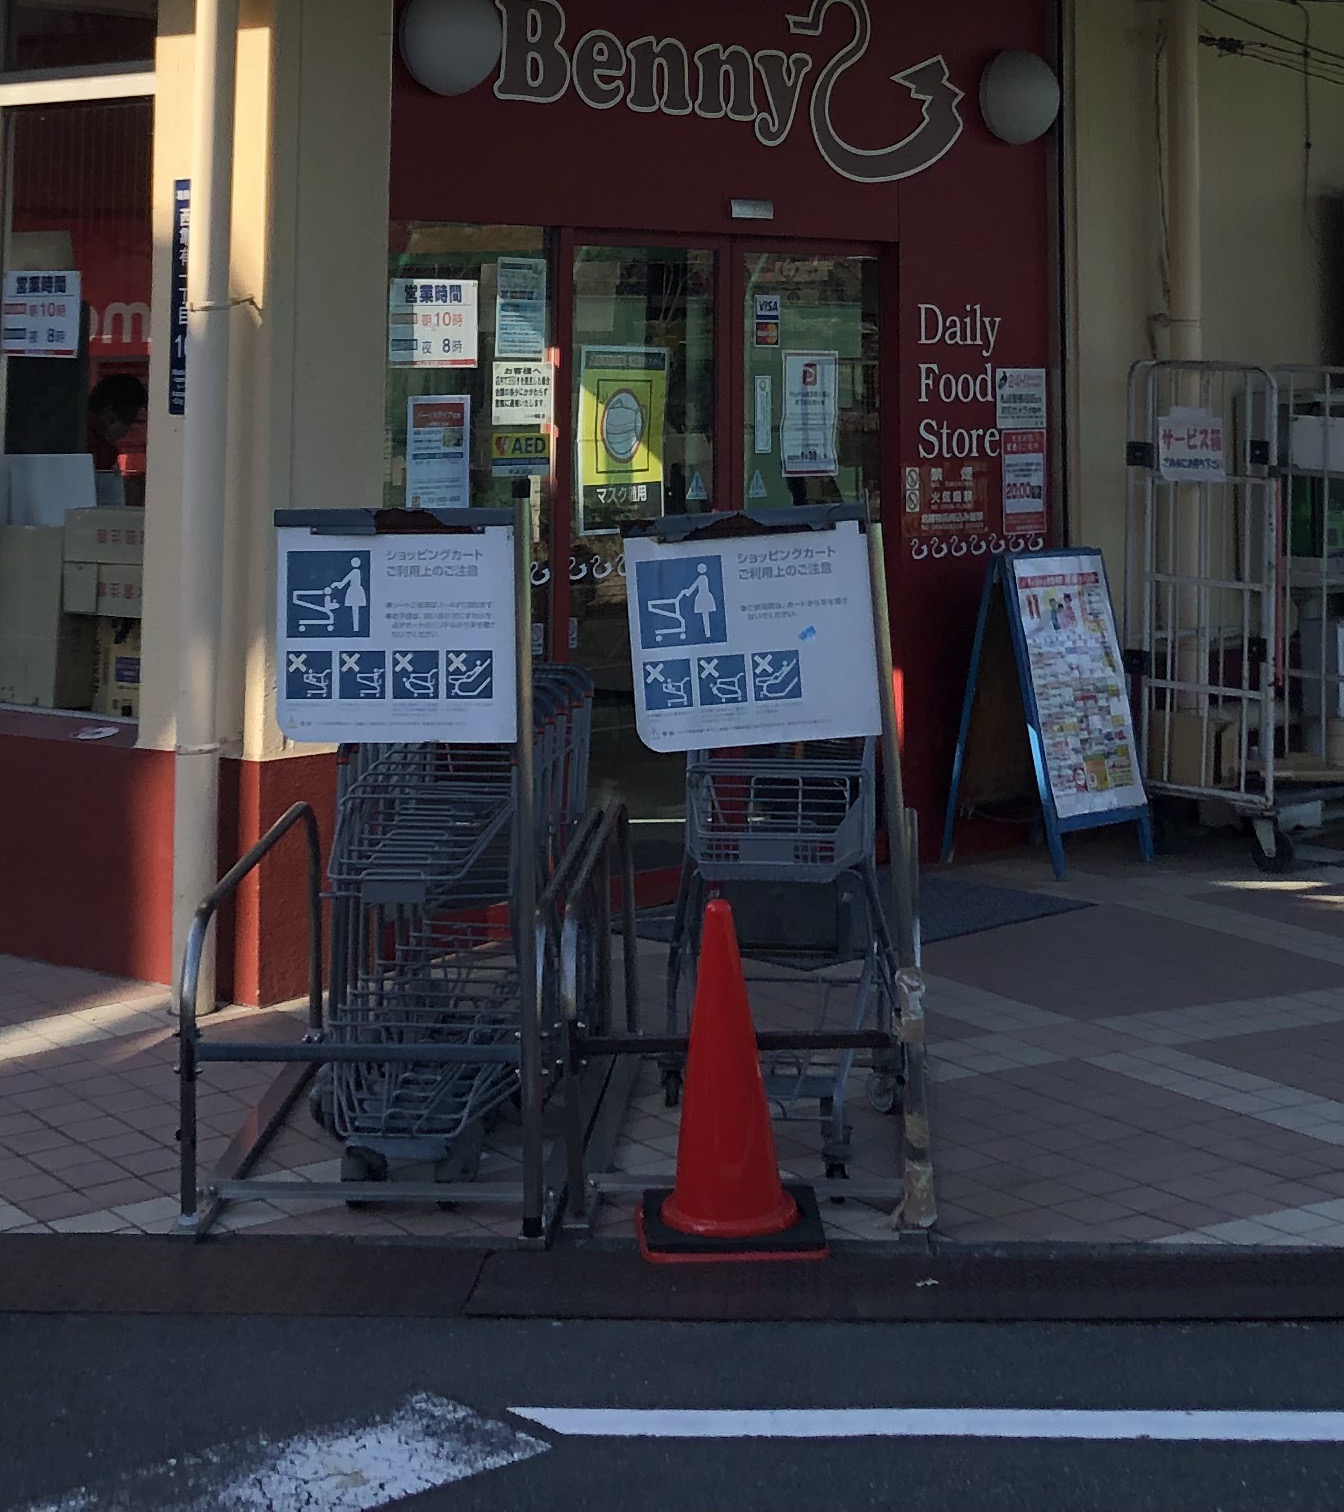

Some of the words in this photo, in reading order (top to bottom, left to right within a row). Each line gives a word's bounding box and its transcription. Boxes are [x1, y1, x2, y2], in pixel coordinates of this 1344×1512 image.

[16, 276, 67, 294] 営業時間
[404, 284, 463, 304] 営業時間
[758, 300, 778, 312] VISA
[917, 303, 1001, 357] Daily
[917, 363, 995, 403] Food
[511, 437, 546, 453] AED
[918, 418, 1000, 459] Store
[386, 548, 484, 561] ショッピングカート
[737, 546, 836, 564] ショッピングカート
[386, 565, 478, 578] ご利用上のご注意
[739, 561, 832, 580] ご利用上のご注意
